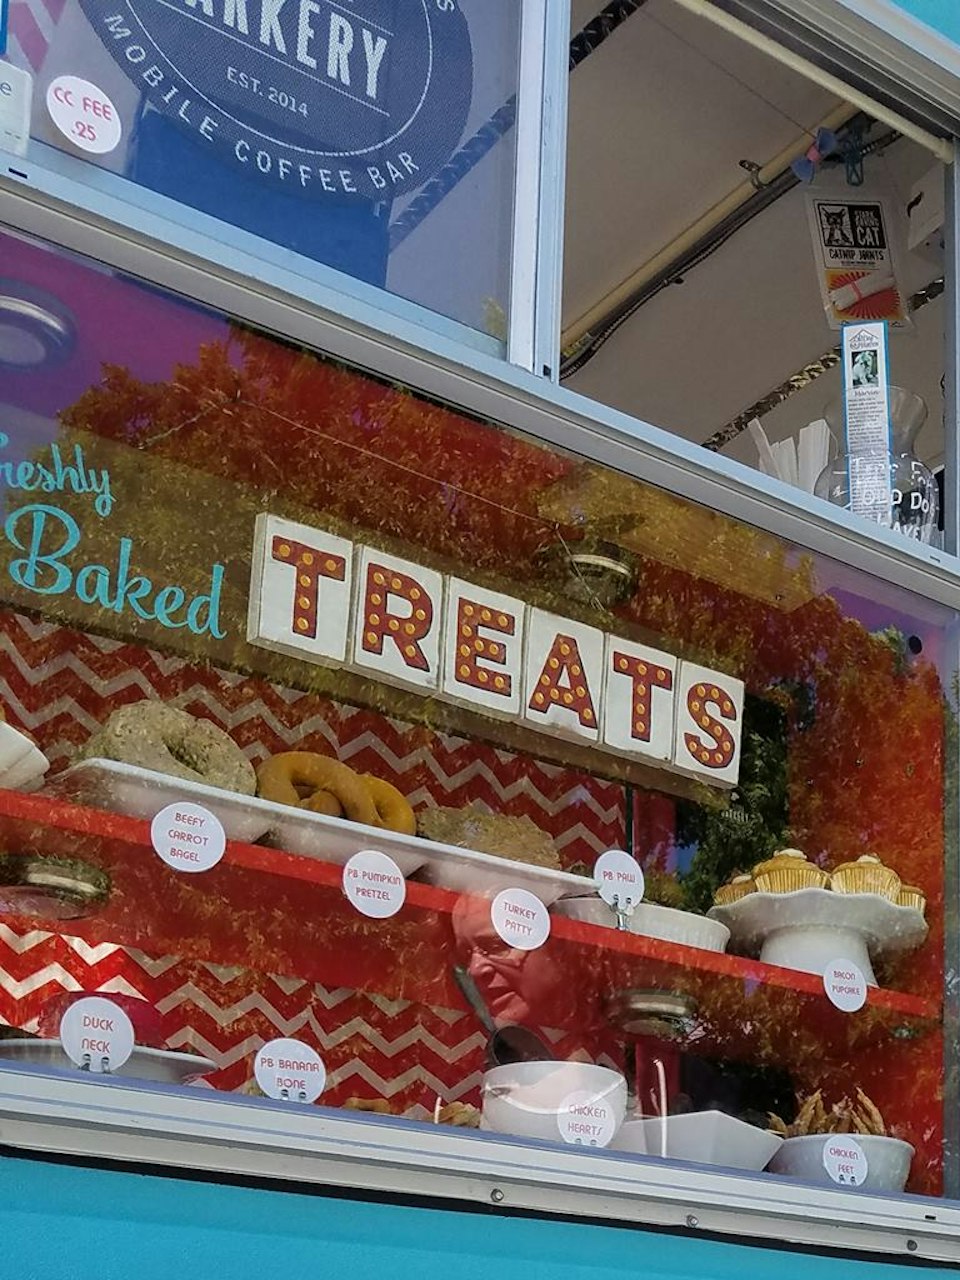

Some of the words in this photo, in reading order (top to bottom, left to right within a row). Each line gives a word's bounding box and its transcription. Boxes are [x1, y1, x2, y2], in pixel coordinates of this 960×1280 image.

[226, 66, 264, 97] EST.
[268, 86, 309, 118] 2014
[53, 87, 73, 107] CC
[83, 97, 112, 121] FEE
[104, 14, 219, 142] MOBILE
[234, 139, 357, 193] COFFEE
[367, 151, 420, 190] BAR
[857, 226, 880, 247] CAT
[0, 432, 117, 518] reshly
[5, 503, 228, 640] Baked
[271, 534, 738, 769] TREATS
[174, 812, 206, 828] BEEFY
[168, 829, 209, 847] CARROT
[170, 847, 200, 863] BAGEL
[347, 868, 359, 879] PB
[602, 870, 614, 881] PB
[617, 872, 636, 884] PAW
[355, 887, 391, 901] PRETZEL
[503, 902, 538, 921] TURKEY
[504, 919, 533, 936] PATTY
[83, 1015, 114, 1032] DUCK
[81, 1038, 110, 1054] NECK
[260, 1056, 275, 1068] PB
[278, 1059, 320, 1073] BANANA
[276, 1076, 306, 1090] BONE
[569, 1104, 607, 1119] CHICKEN
[567, 1122, 604, 1136] HEARTS
[829, 1147, 859, 1161] CHICKEN
[837, 1163, 854, 1175] FEET
